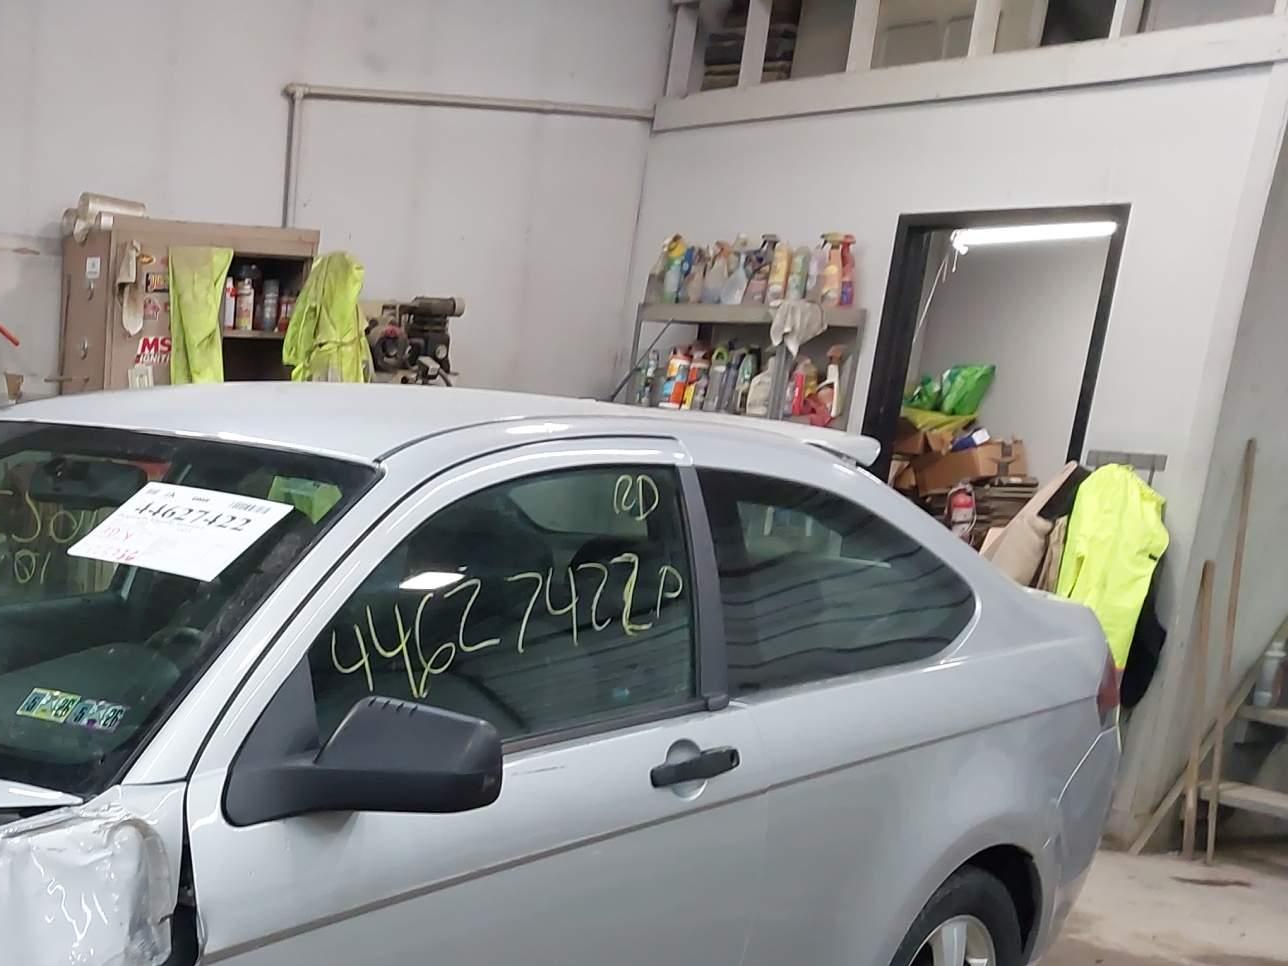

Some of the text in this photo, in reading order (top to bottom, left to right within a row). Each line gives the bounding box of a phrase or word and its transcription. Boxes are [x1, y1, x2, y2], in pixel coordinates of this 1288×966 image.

[140, 337, 172, 354] MS
[141, 353, 170, 364] IGNITI
[135, 501, 252, 531] 44627422
